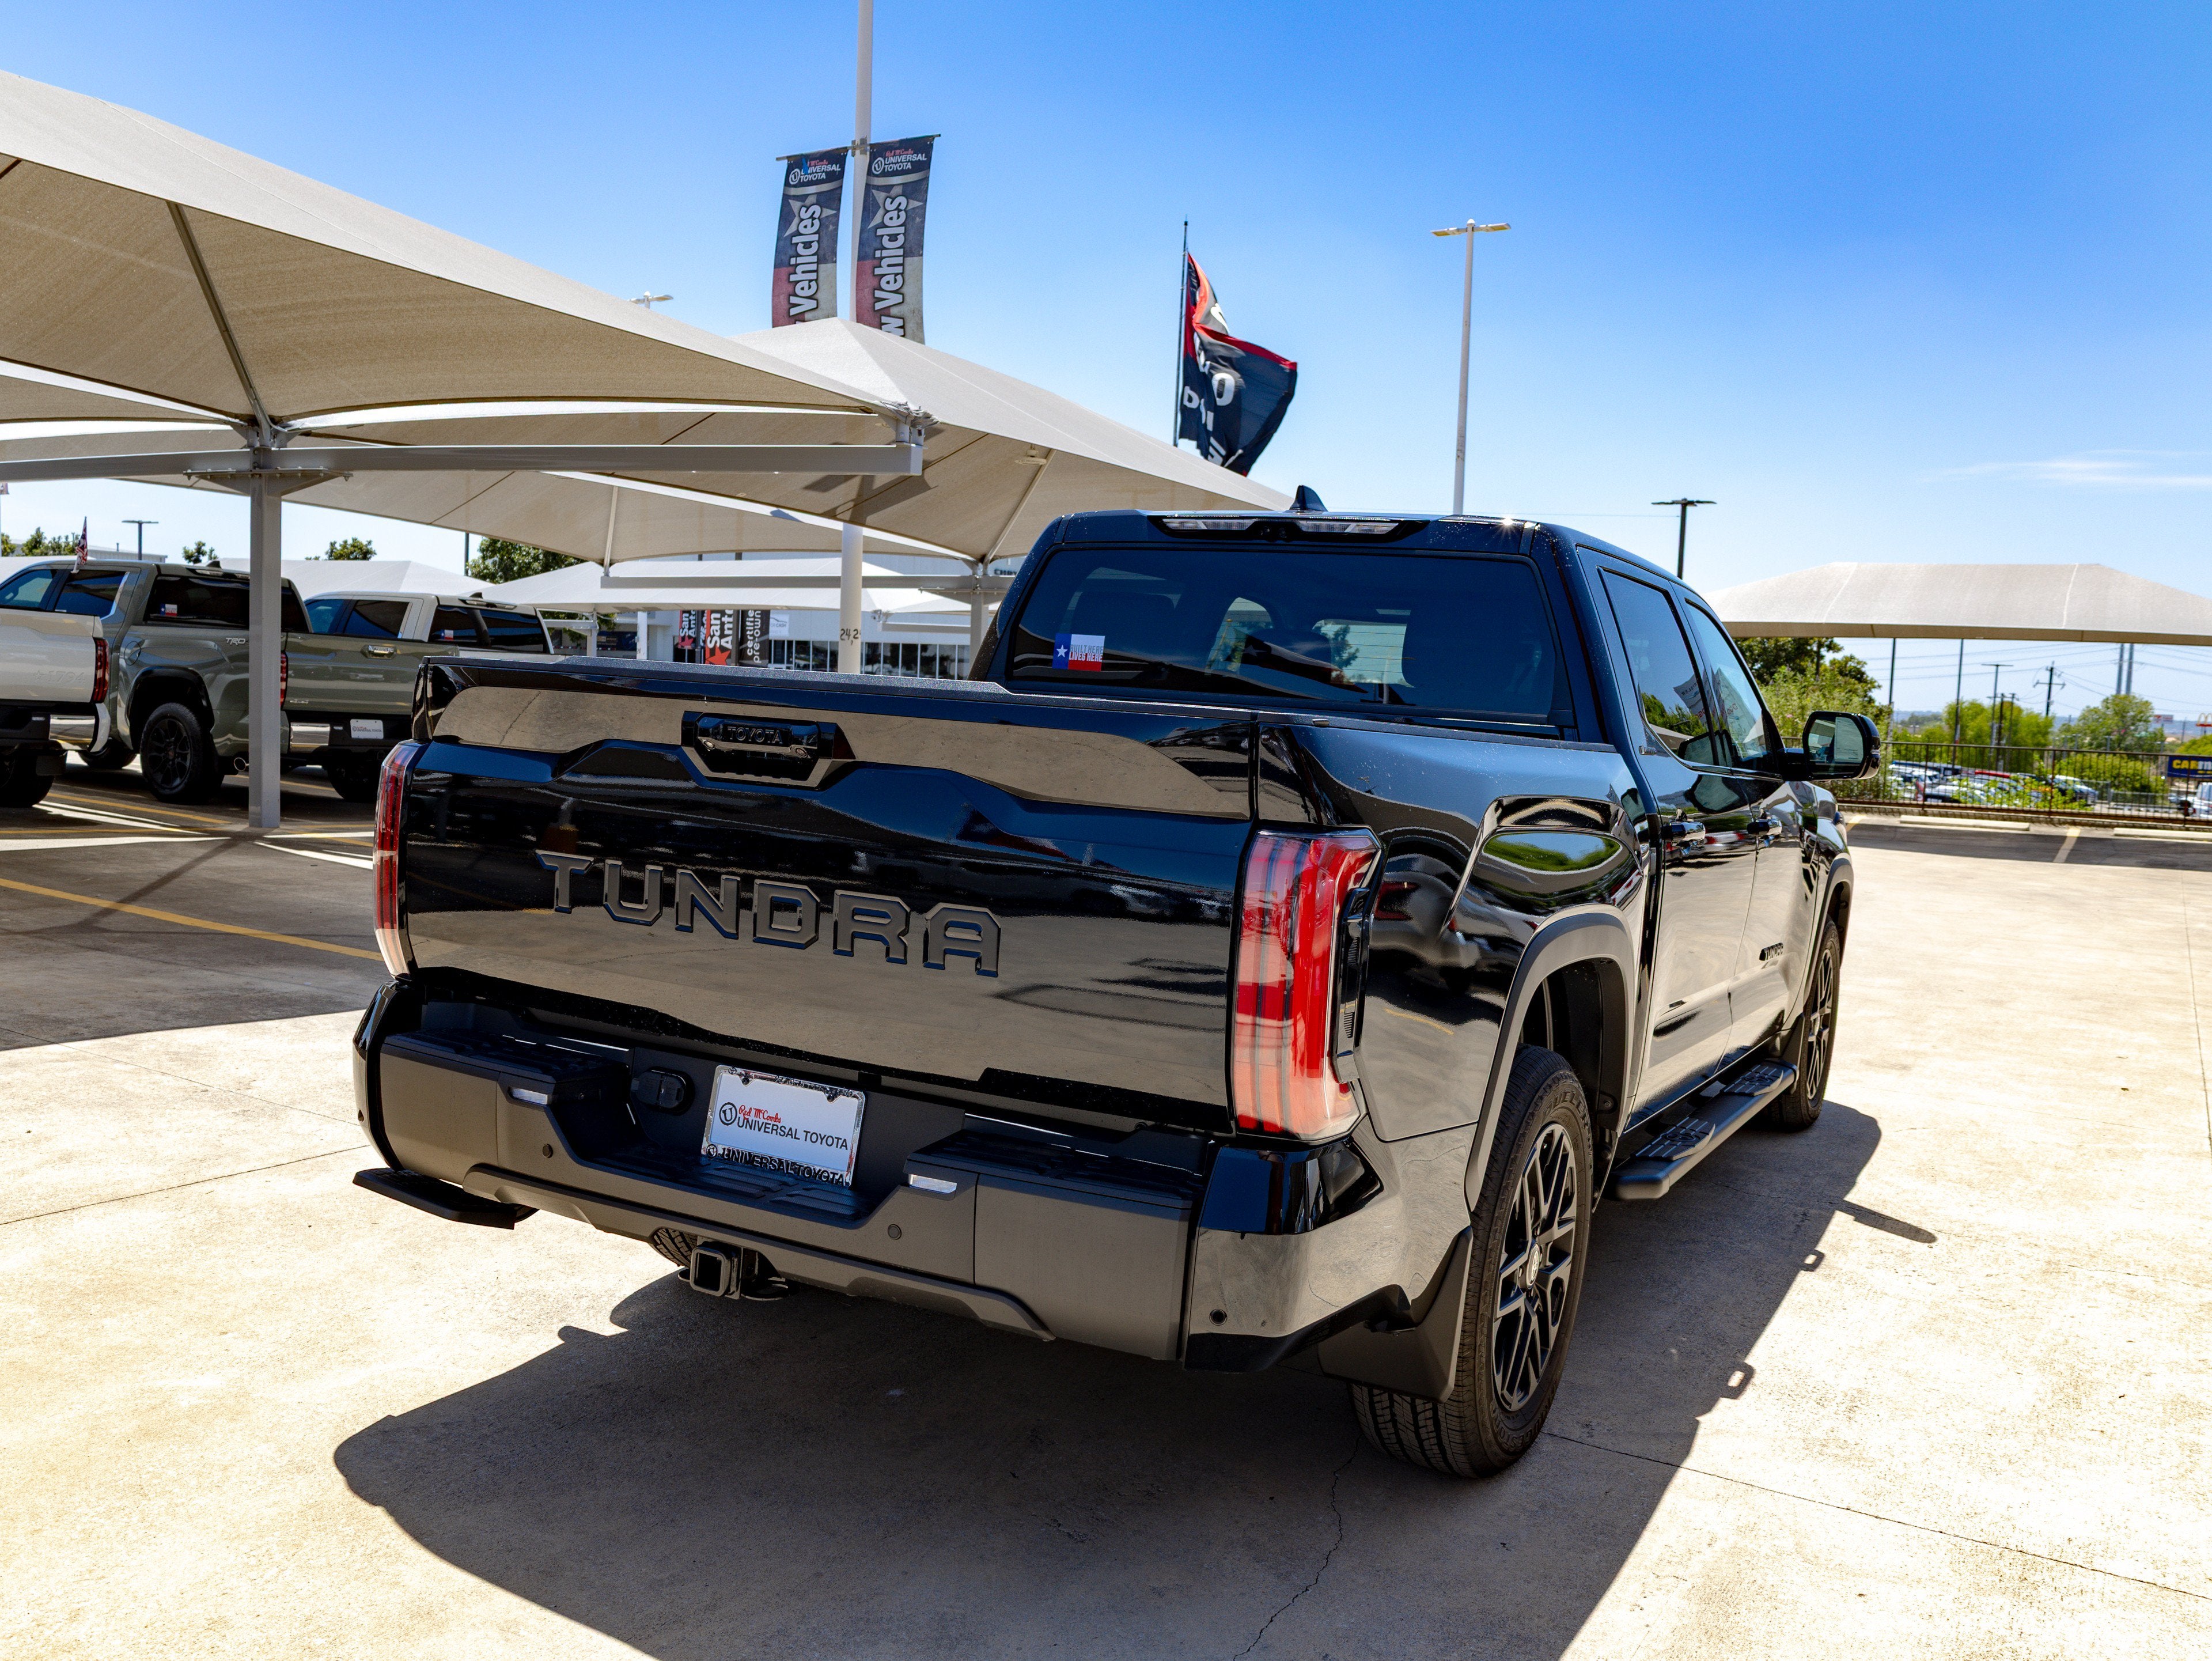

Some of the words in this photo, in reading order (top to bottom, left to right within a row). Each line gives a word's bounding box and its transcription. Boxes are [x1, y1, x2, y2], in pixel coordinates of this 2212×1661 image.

[885, 153, 927, 164] UNIVERSAL
[884, 162, 912, 172] TOYOTA
[800, 173, 826, 182] TOYOTA
[680, 612, 689, 637] San
[707, 612, 721, 649] San
[226, 637, 246, 645] TRD
[1070, 644, 1086, 653] BUILT
[1088, 645, 1104, 654] HERE
[1069, 652, 1086, 661] LIVES
[1086, 653, 1103, 662] HERE
[48, 671, 85, 684] 1794
[727, 726, 783, 744] TOYOTA
[535, 849, 1002, 978] TUNDRA
[738, 1104, 752, 1120] Red
[753, 1107, 781, 1123] McCombs
[737, 1116, 800, 1140] UNIVERSAL
[803, 1130, 848, 1151] TOYOTA
[722, 1147, 794, 1175] UNIVERSAL
[794, 1164, 846, 1187] TOYOTA
